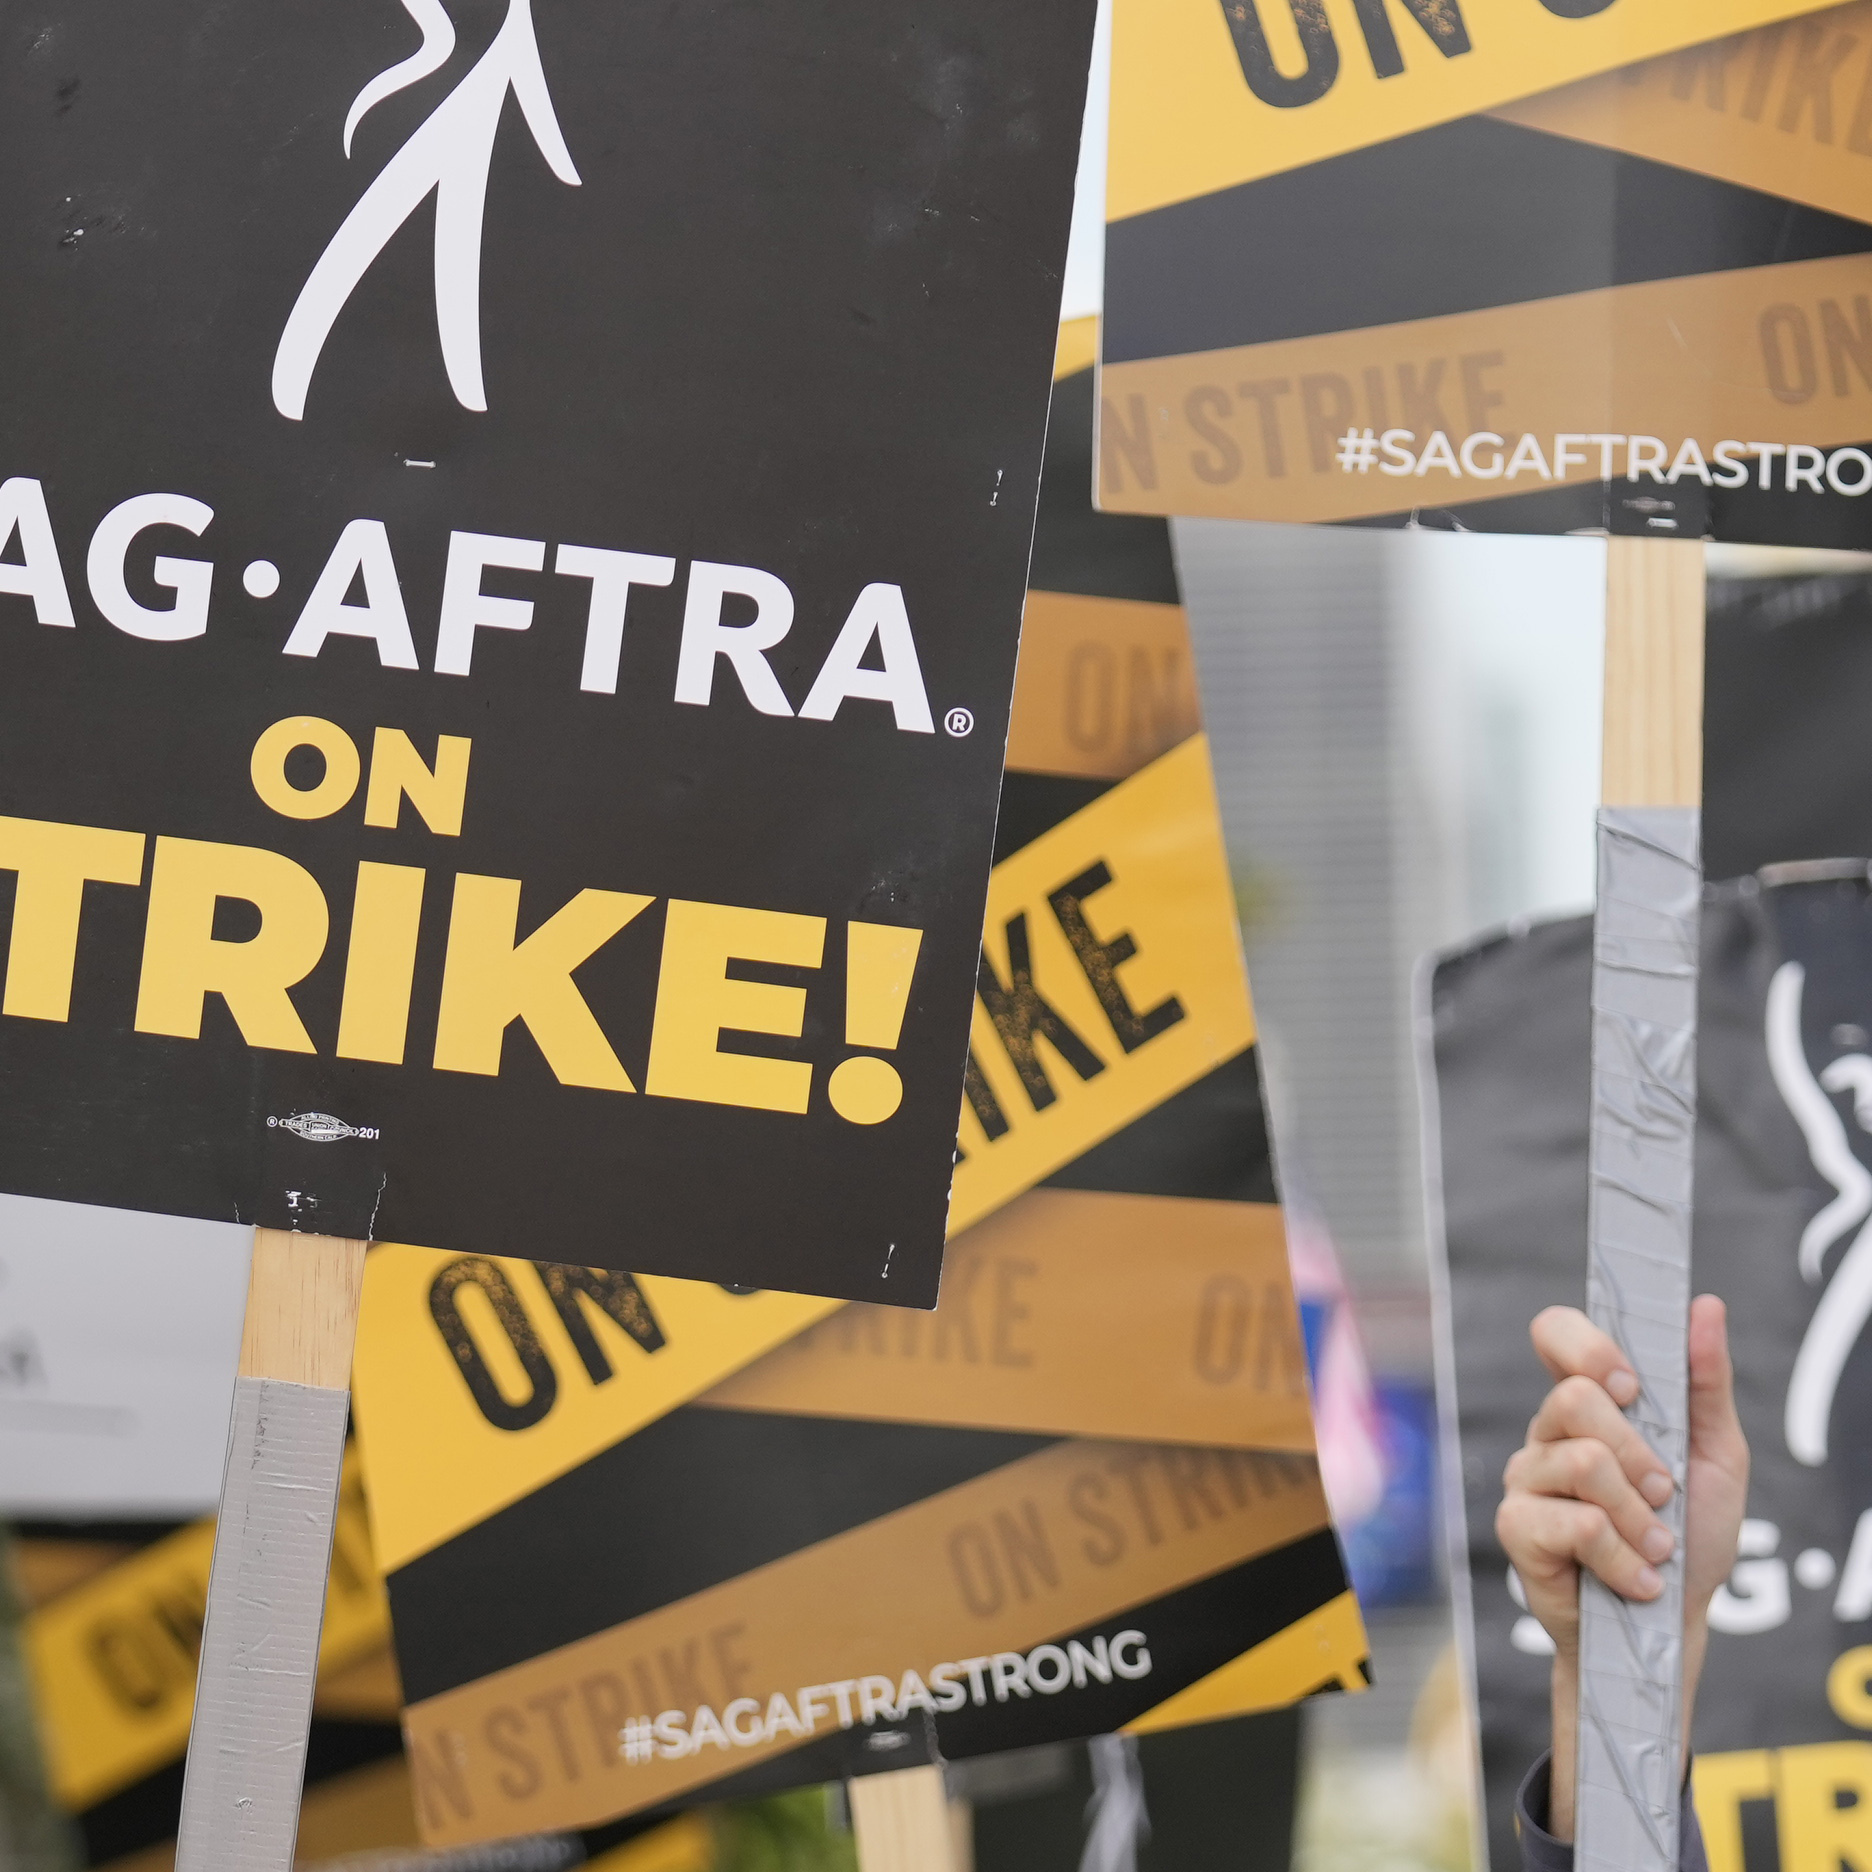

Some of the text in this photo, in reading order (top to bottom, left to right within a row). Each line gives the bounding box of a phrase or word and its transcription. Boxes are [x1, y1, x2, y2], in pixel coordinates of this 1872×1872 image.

[249, 713, 472, 837] ON
[358, 1127, 380, 1140] 201
[430, 1255, 668, 1432] ON
[947, 1498, 1062, 1620] ON
[617, 1626, 1156, 1768] #SAGAFTRASTRONG
